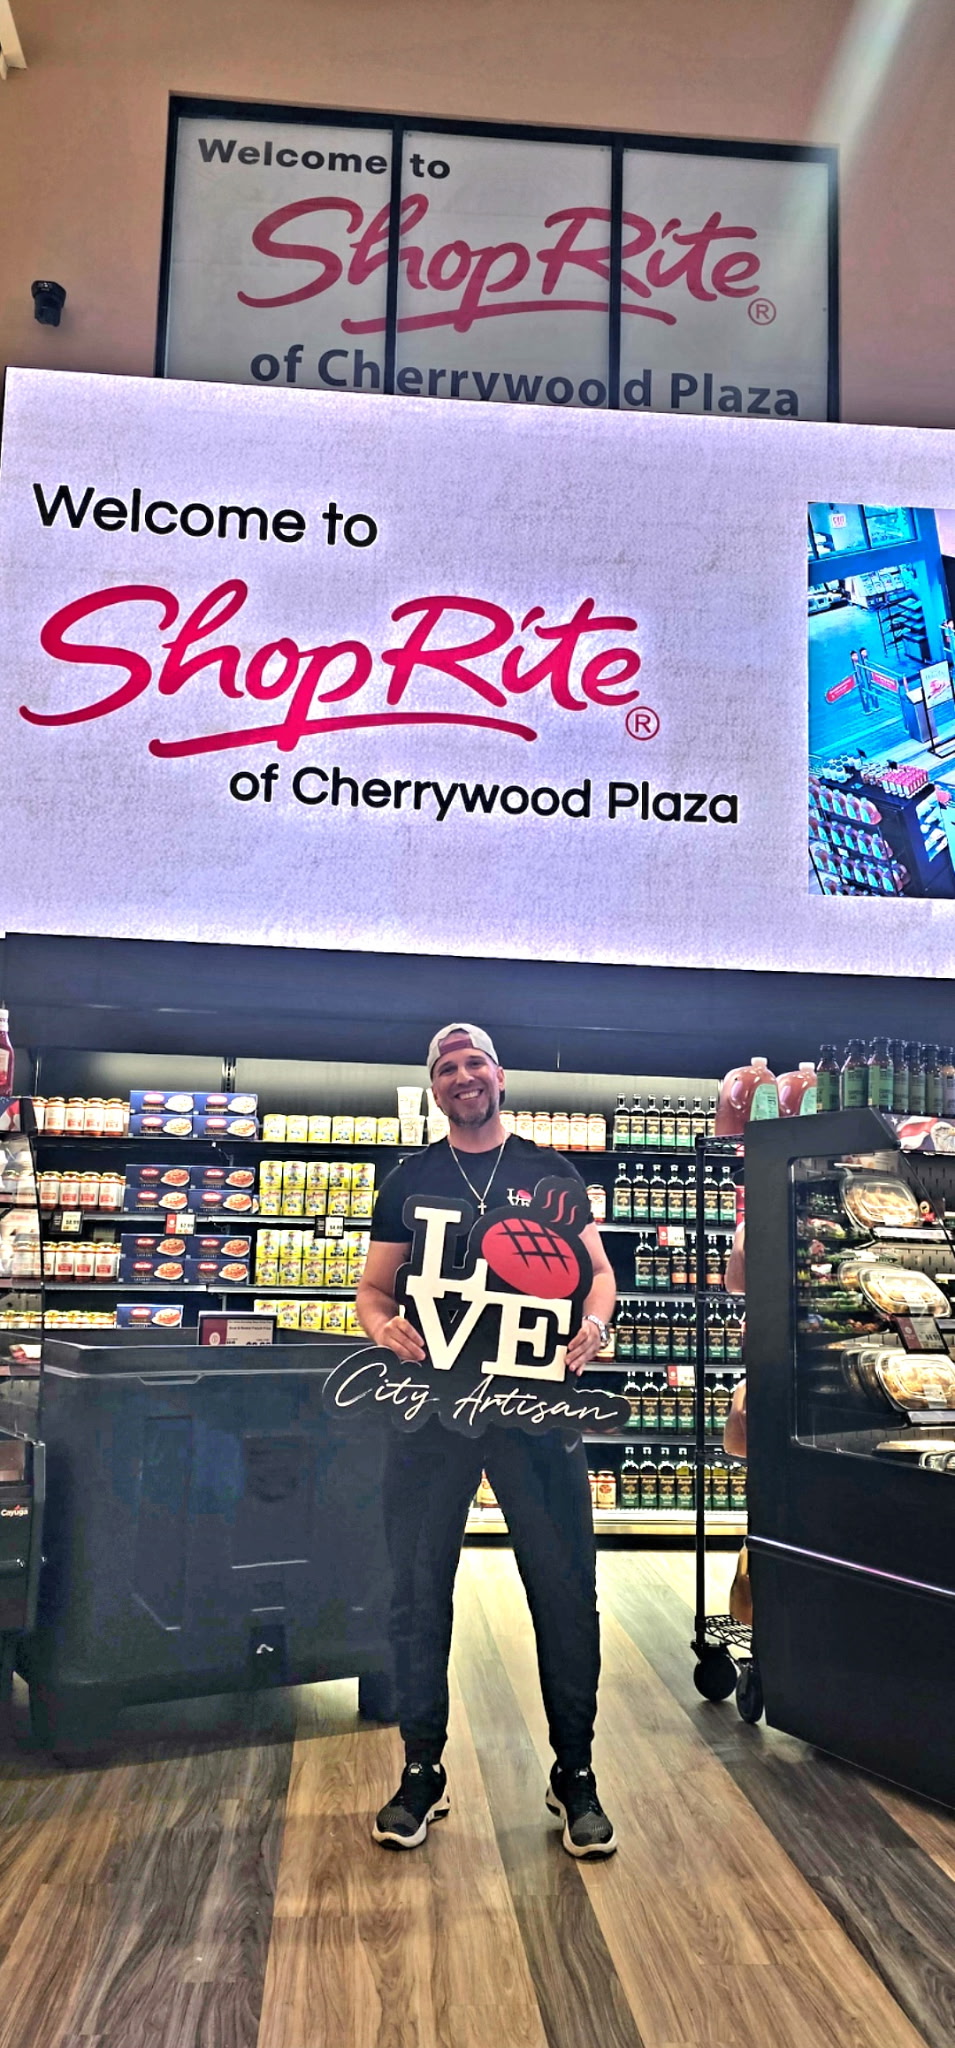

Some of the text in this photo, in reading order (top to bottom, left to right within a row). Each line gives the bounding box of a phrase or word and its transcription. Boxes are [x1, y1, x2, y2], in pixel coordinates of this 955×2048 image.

[198, 138, 450, 180] Welcome to
[237, 193, 761, 334] ShopRite
[250, 344, 799, 417] of Cherrywood Plaza
[32, 484, 378, 547] Welcome to
[20, 579, 642, 758] ShopRite
[229, 763, 739, 823] of Cherrywood Plaza
[334, 1362, 434, 1421] City
[452, 1374, 619, 1426] Artisan
